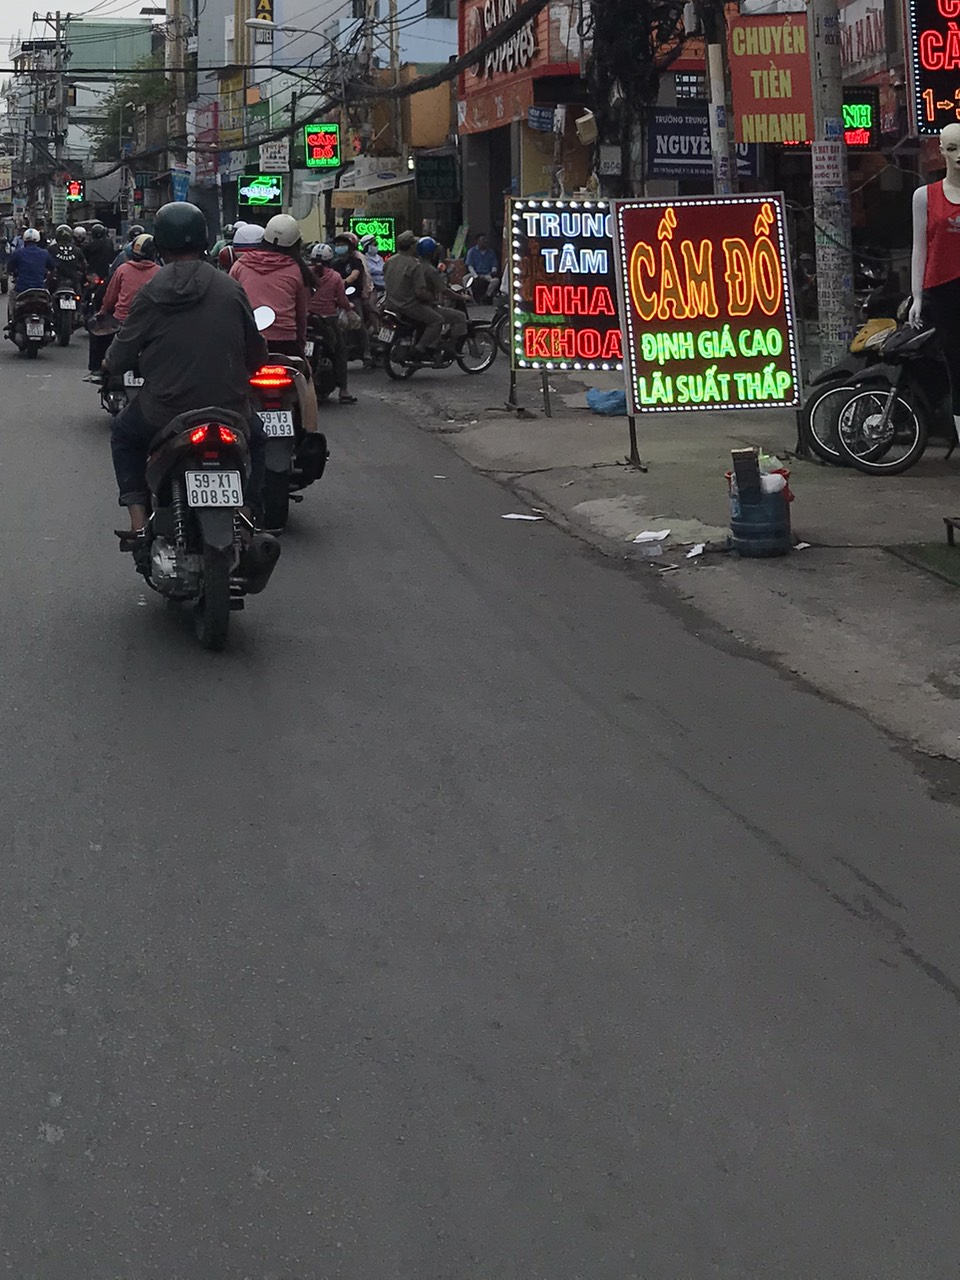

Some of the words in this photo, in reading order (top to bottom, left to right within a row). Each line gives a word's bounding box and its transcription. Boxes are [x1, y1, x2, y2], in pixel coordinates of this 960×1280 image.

[732, 14, 806, 56] CHUYỂN
[750, 60, 792, 99] TIỀN
[656, 127, 710, 155] NGUYỄ
[742, 113, 807, 143] NHANH
[541, 243, 608, 274] TÂM
[630, 207, 719, 321] CẦM
[722, 204, 782, 316] ĐỒ
[535, 285, 615, 315] NHA
[524, 328, 624, 359] KHOA
[641, 329, 694, 365] ĐỊNH
[697, 324, 736, 359] GIÁ
[739, 328, 783, 357] CAO
[638, 371, 674, 405] LÃI
[676, 365, 730, 404] SUẤT
[733, 363, 791, 401] THẤP
[193, 473, 232, 489] 59-X1
[190, 488, 240, 506] 808.59
